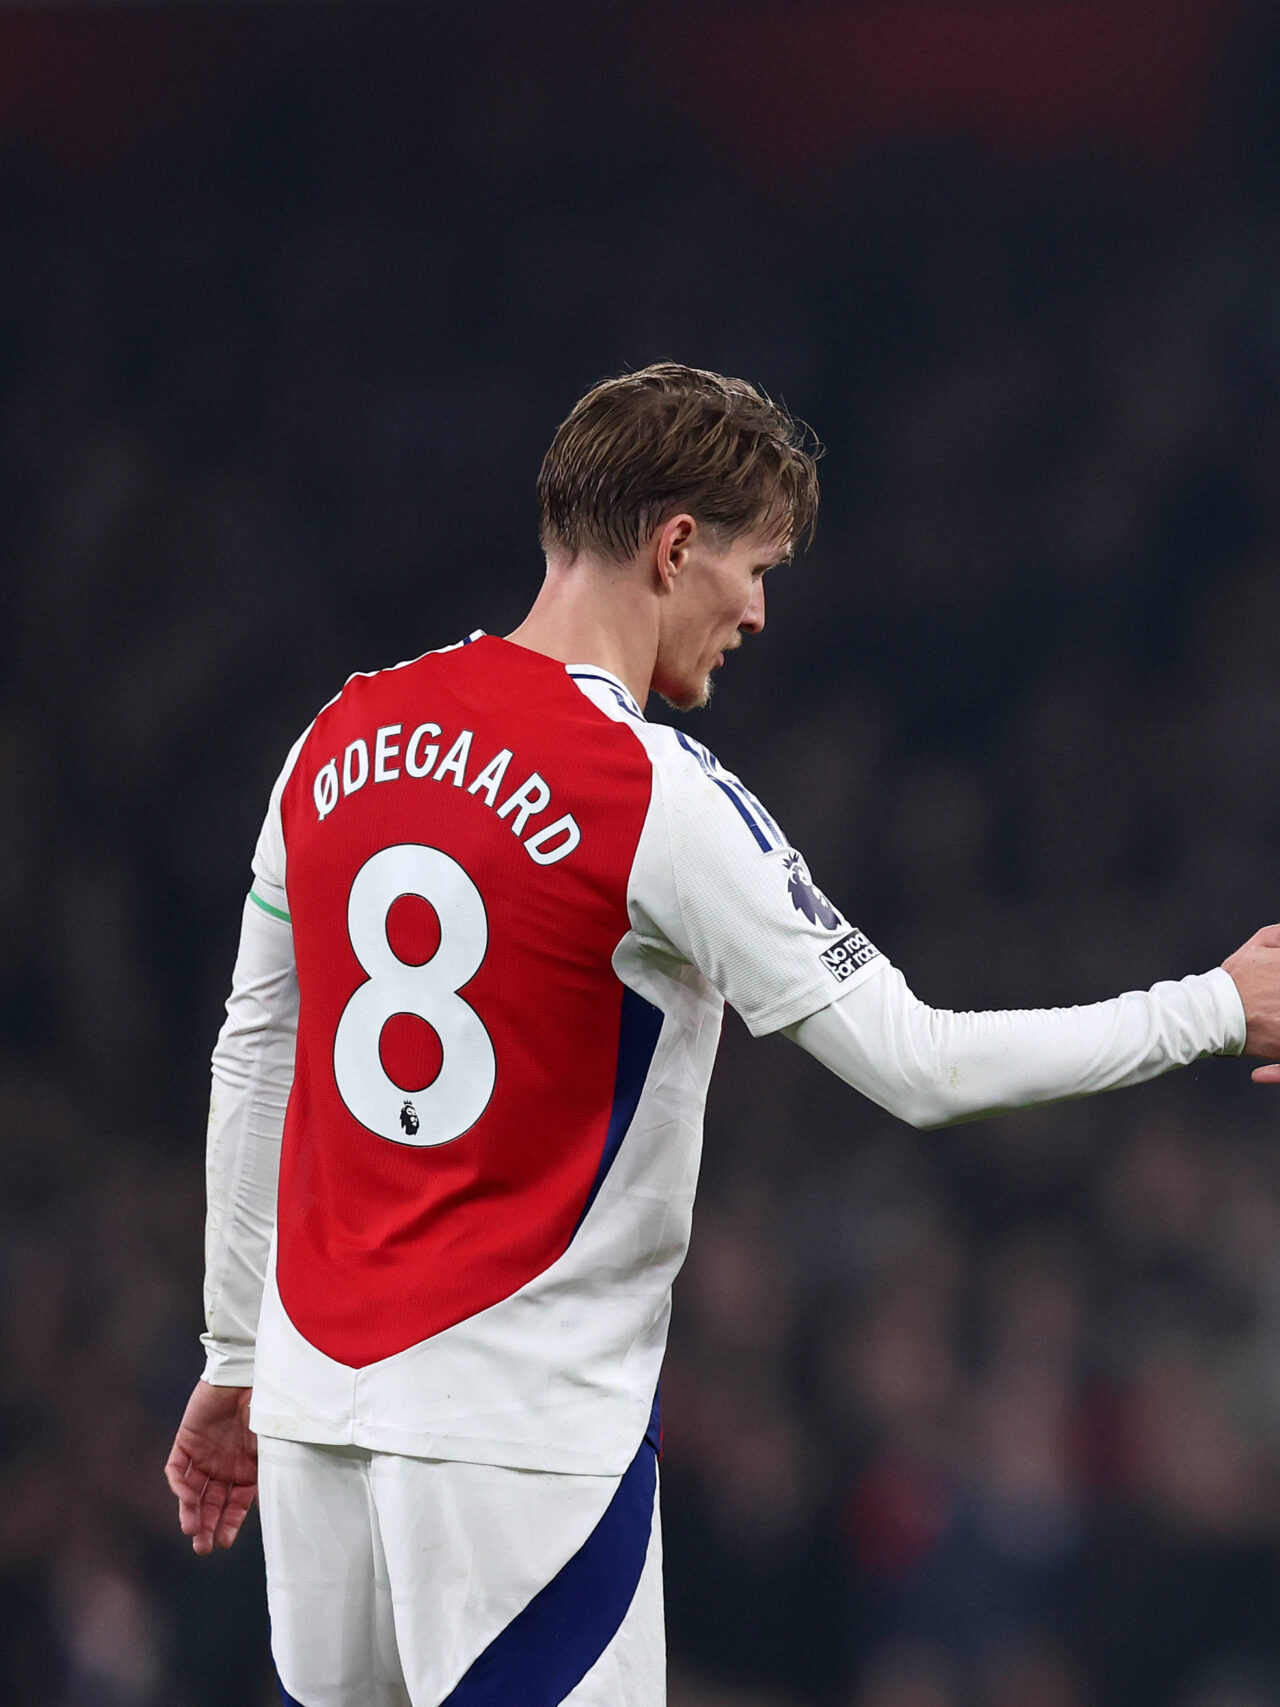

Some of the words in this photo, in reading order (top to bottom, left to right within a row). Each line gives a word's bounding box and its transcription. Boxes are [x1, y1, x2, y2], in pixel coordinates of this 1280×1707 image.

[313, 722, 581, 866] ØDEGAARD
[333, 842, 497, 1148] 8
[820, 947, 847, 970] No
[843, 933, 870, 955] roo
